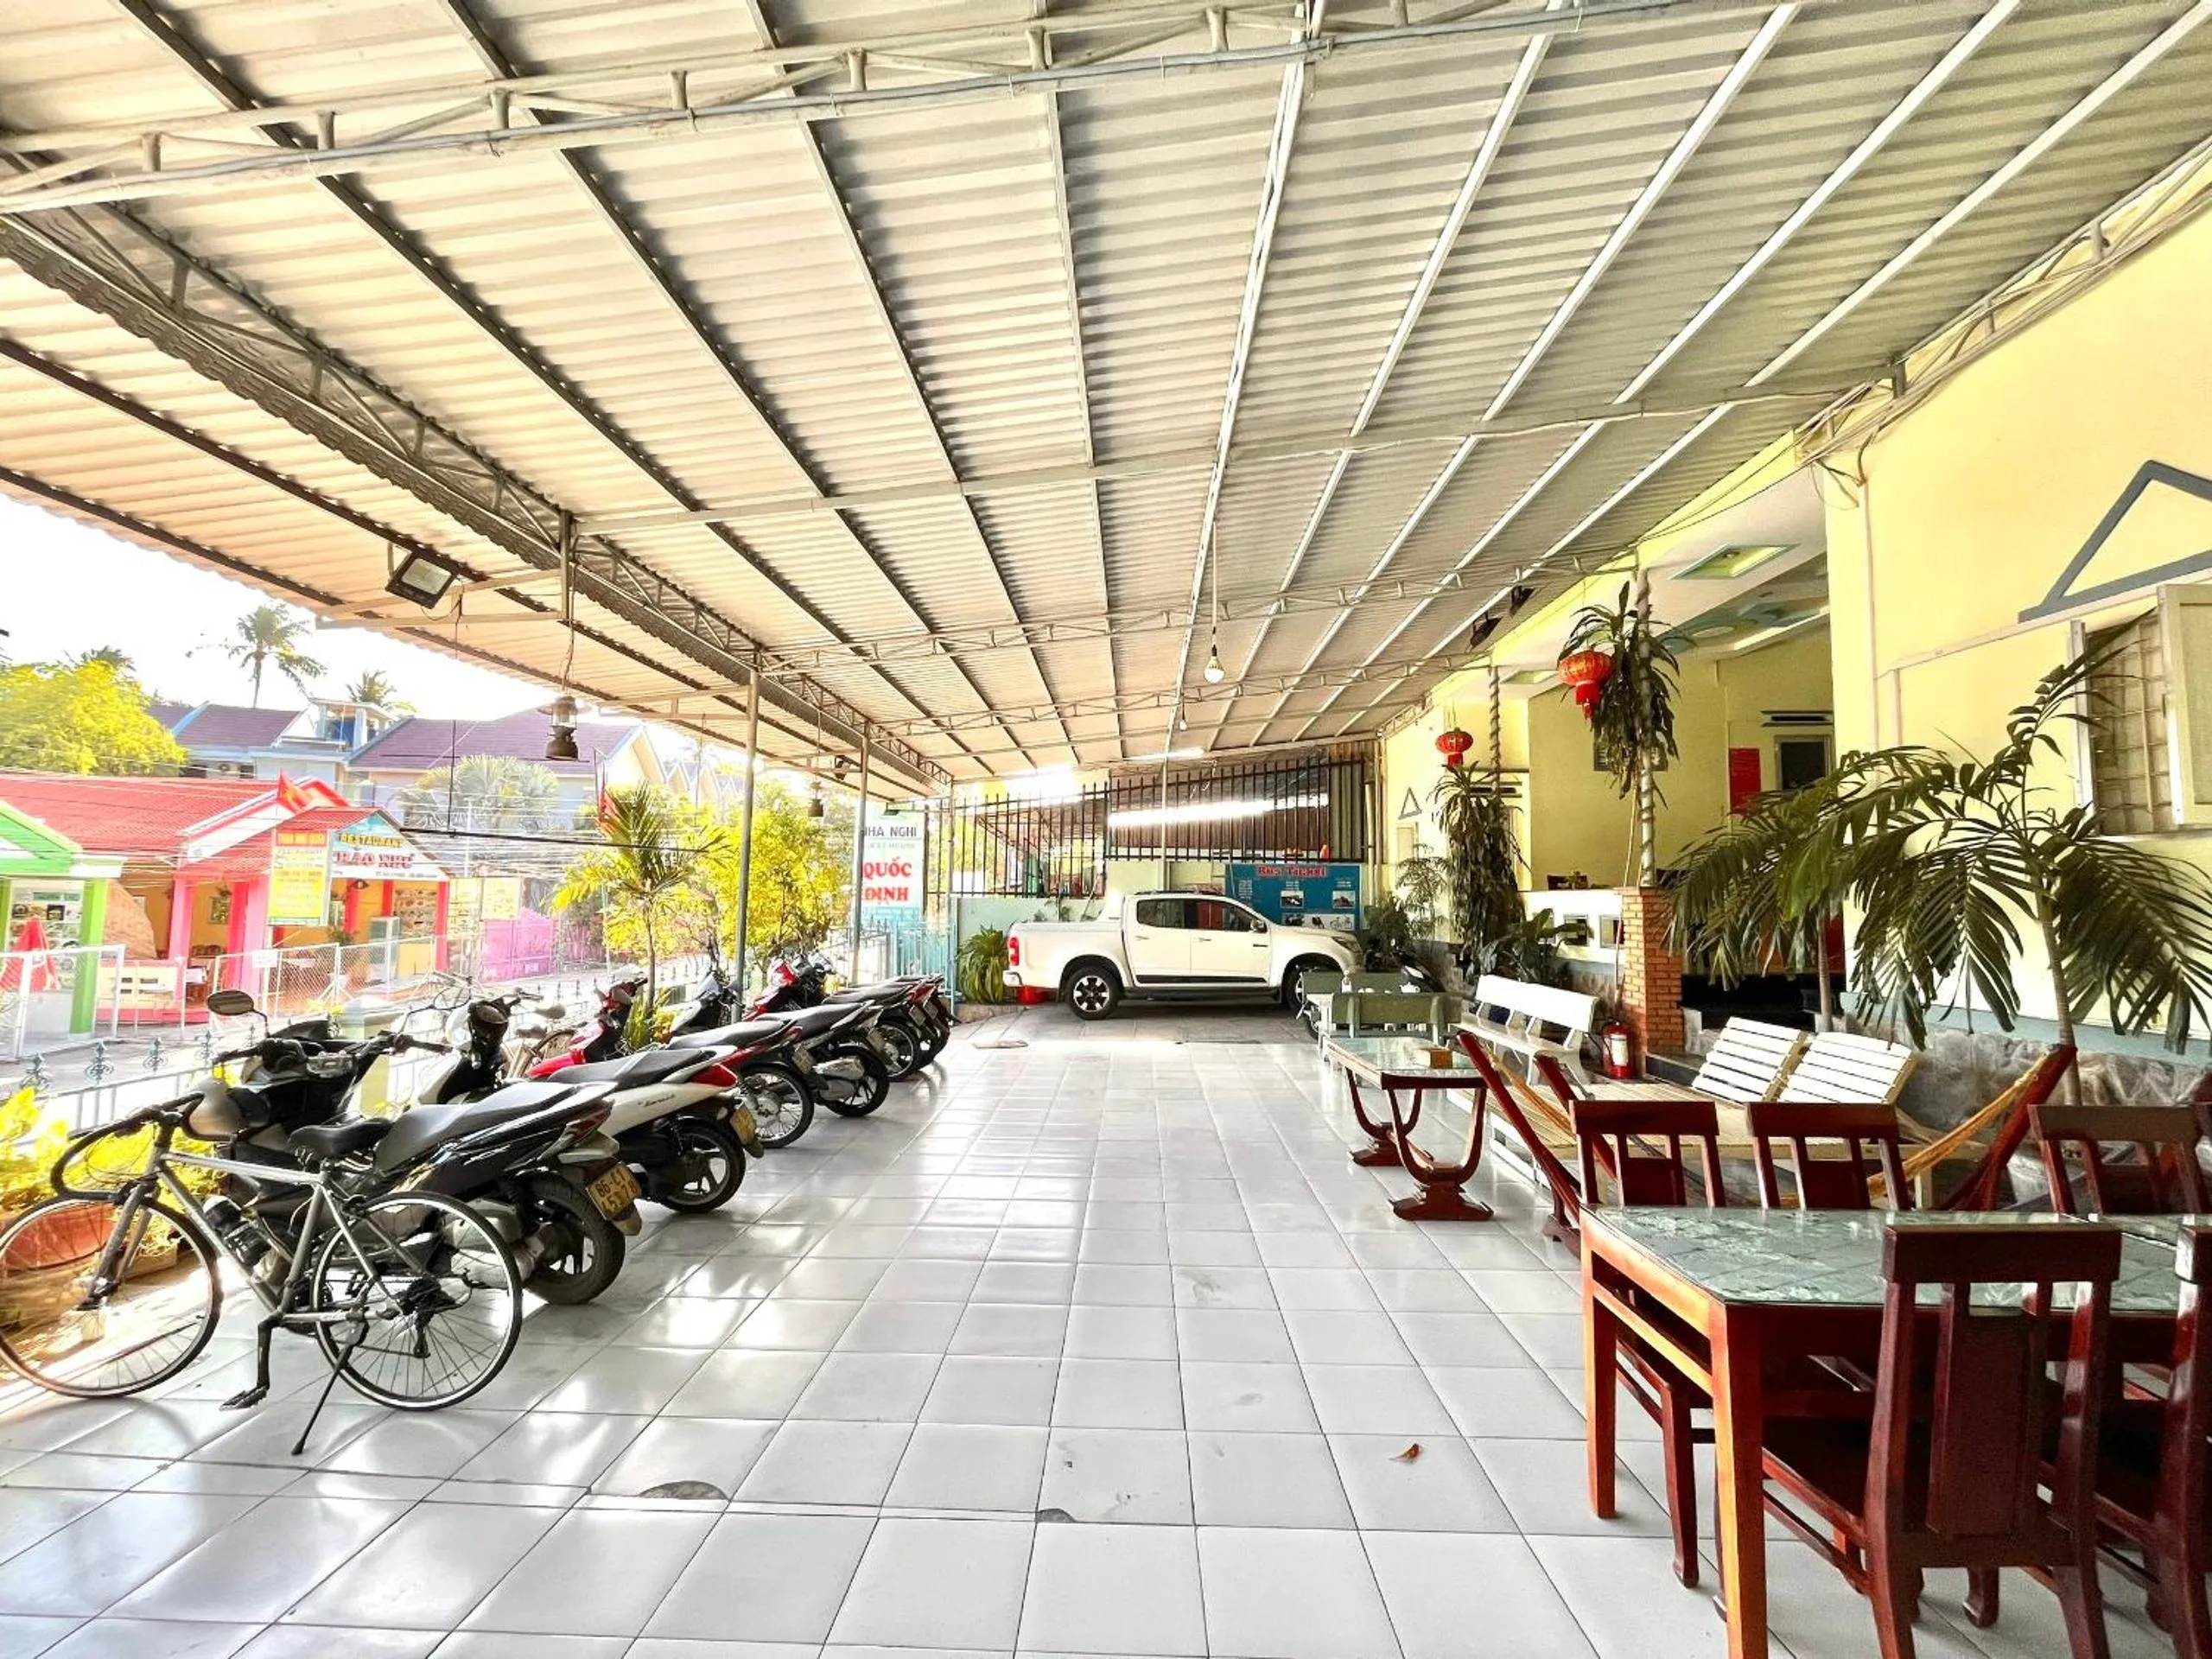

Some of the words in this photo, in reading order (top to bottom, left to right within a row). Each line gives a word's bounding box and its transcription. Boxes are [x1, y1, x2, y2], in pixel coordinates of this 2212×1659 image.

[340, 833, 403, 849] RESTAURANT
[862, 855, 912, 880] QUỐC
[863, 887, 909, 905] ĐỊNH
[595, 1167, 626, 1198] 86-C1
